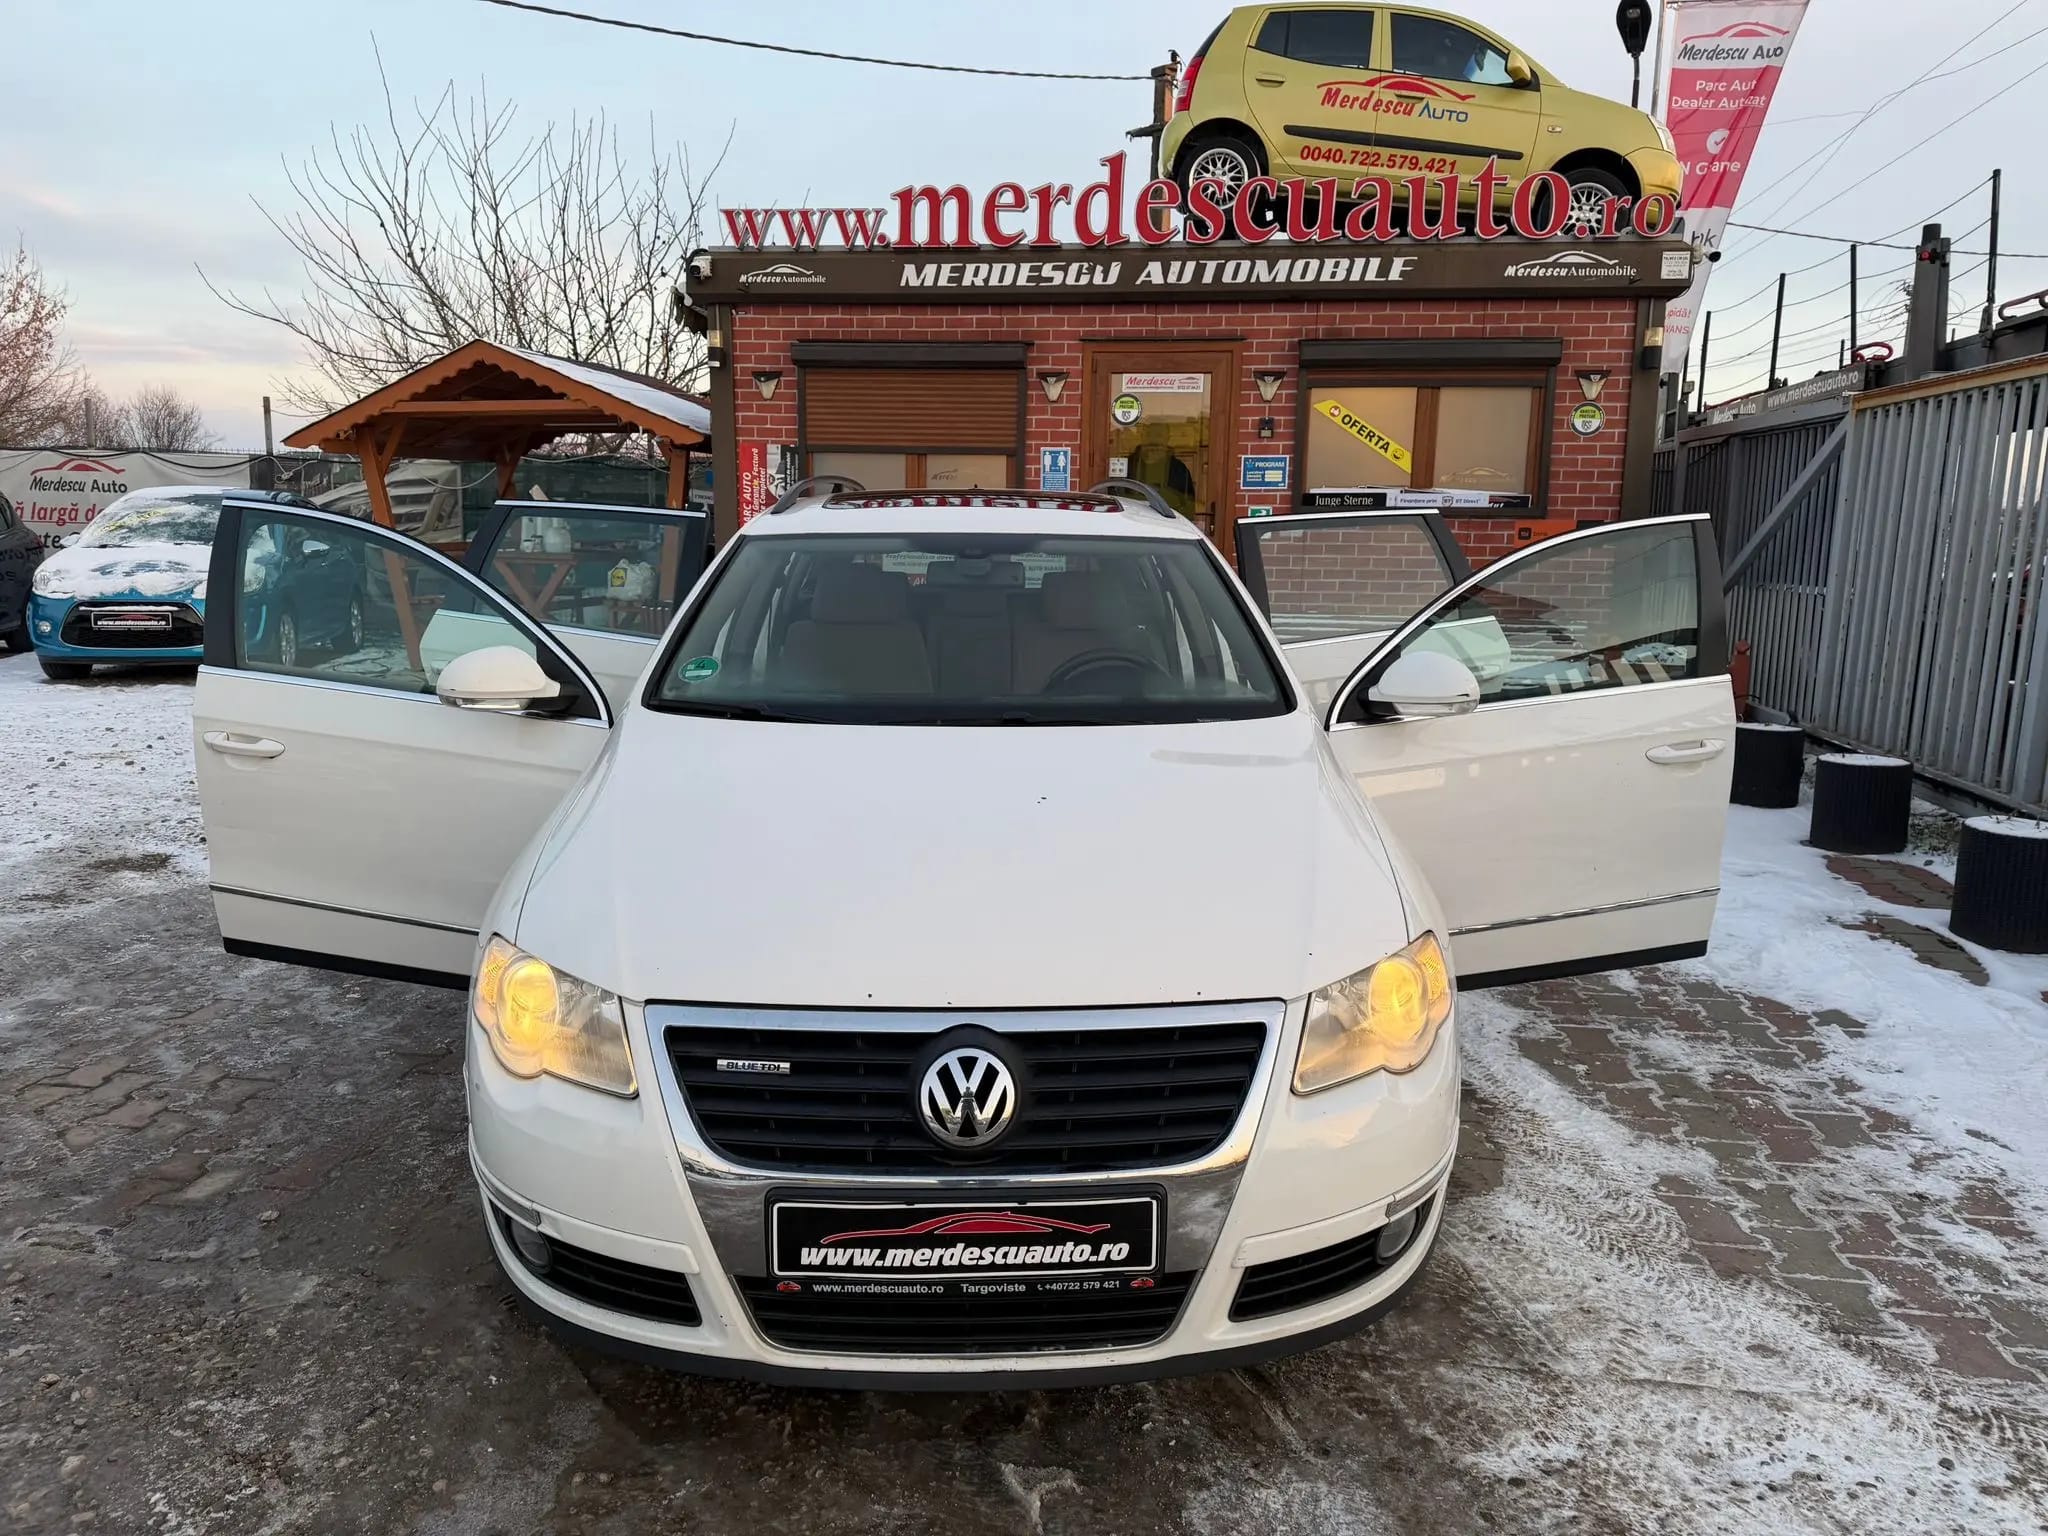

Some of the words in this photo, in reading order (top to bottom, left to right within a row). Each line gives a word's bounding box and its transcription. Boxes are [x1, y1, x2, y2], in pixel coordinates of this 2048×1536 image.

[1677, 44, 1749, 61] Merdescu
[1695, 80, 1727, 92] Parc
[1321, 86, 1416, 117] Merdescu
[1672, 96, 1715, 108] Dealer
[1299, 145, 1458, 174] 0040.722.579.421
[719, 150, 1677, 251] www.merdescuauto.ro
[900, 262, 1123, 288] MERDESCU
[1135, 257, 1417, 285] AUTOMOBILE
[1664, 325, 1690, 335] VANS
[1126, 376, 1177, 386] Merdescu
[1767, 371, 1860, 409] www.merdescuauto.ro
[1341, 413, 1391, 454] OFERTA
[30, 475, 87, 492] Merdescu
[91, 479, 128, 494] Auto
[743, 471, 752, 503] AUTO
[1315, 495, 1342, 507] Junge
[1343, 495, 1374, 506] Sterne
[31, 501, 80, 527] largă
[743, 503, 752, 523] ARC
[800, 1239, 1130, 1269] www.merdescuauto.ro
[812, 1281, 944, 1295] www.merdescuauto.ro
[960, 1282, 1026, 1294] Targoviste
[1044, 1280, 1081, 1292] +40722
[1082, 1280, 1100, 1291] 579
[1102, 1279, 1121, 1290] 421
